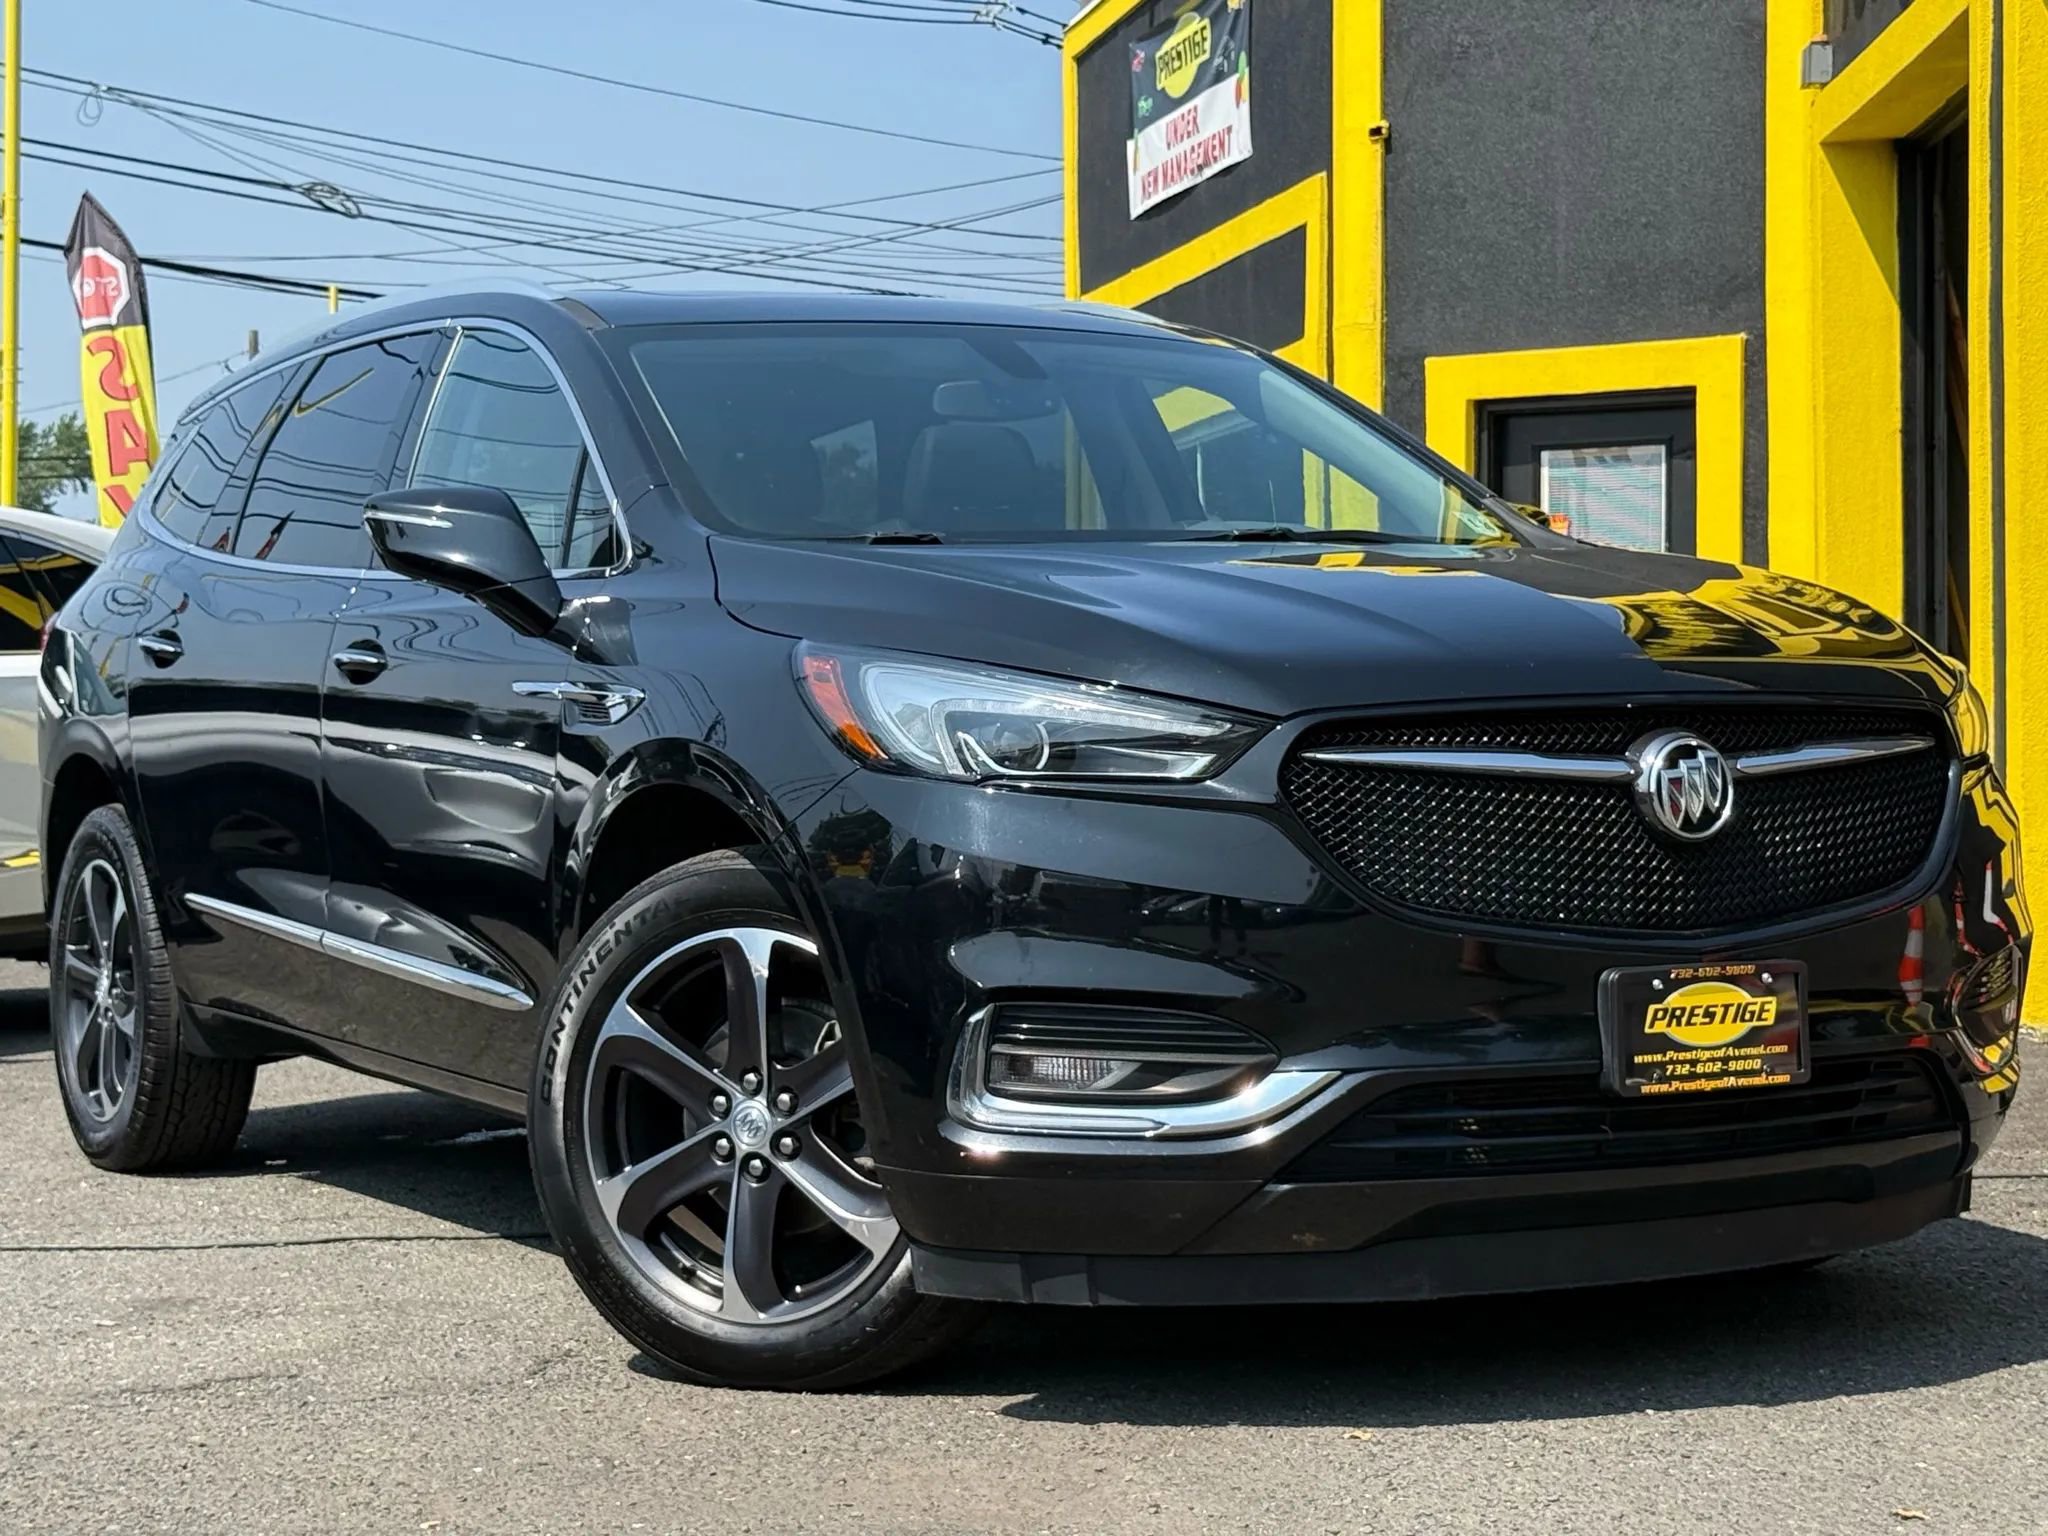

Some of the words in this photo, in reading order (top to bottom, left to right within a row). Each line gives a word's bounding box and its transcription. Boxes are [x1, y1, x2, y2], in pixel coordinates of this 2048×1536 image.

[1157, 25, 1208, 84] PRESTIGE
[1165, 105, 1200, 150] UNDER
[1140, 164, 1160, 202] NEW
[1161, 125, 1233, 191] MANAGEMENT
[1669, 964, 1756, 979] 732-602-9800
[540, 896, 690, 1106] CONTINENTA
[1647, 1000, 1774, 1029] PRESTIGE
[1633, 1044, 1788, 1064] www.PrestigeofAvenel.com
[1665, 1058, 1761, 1076] 732-602-9800
